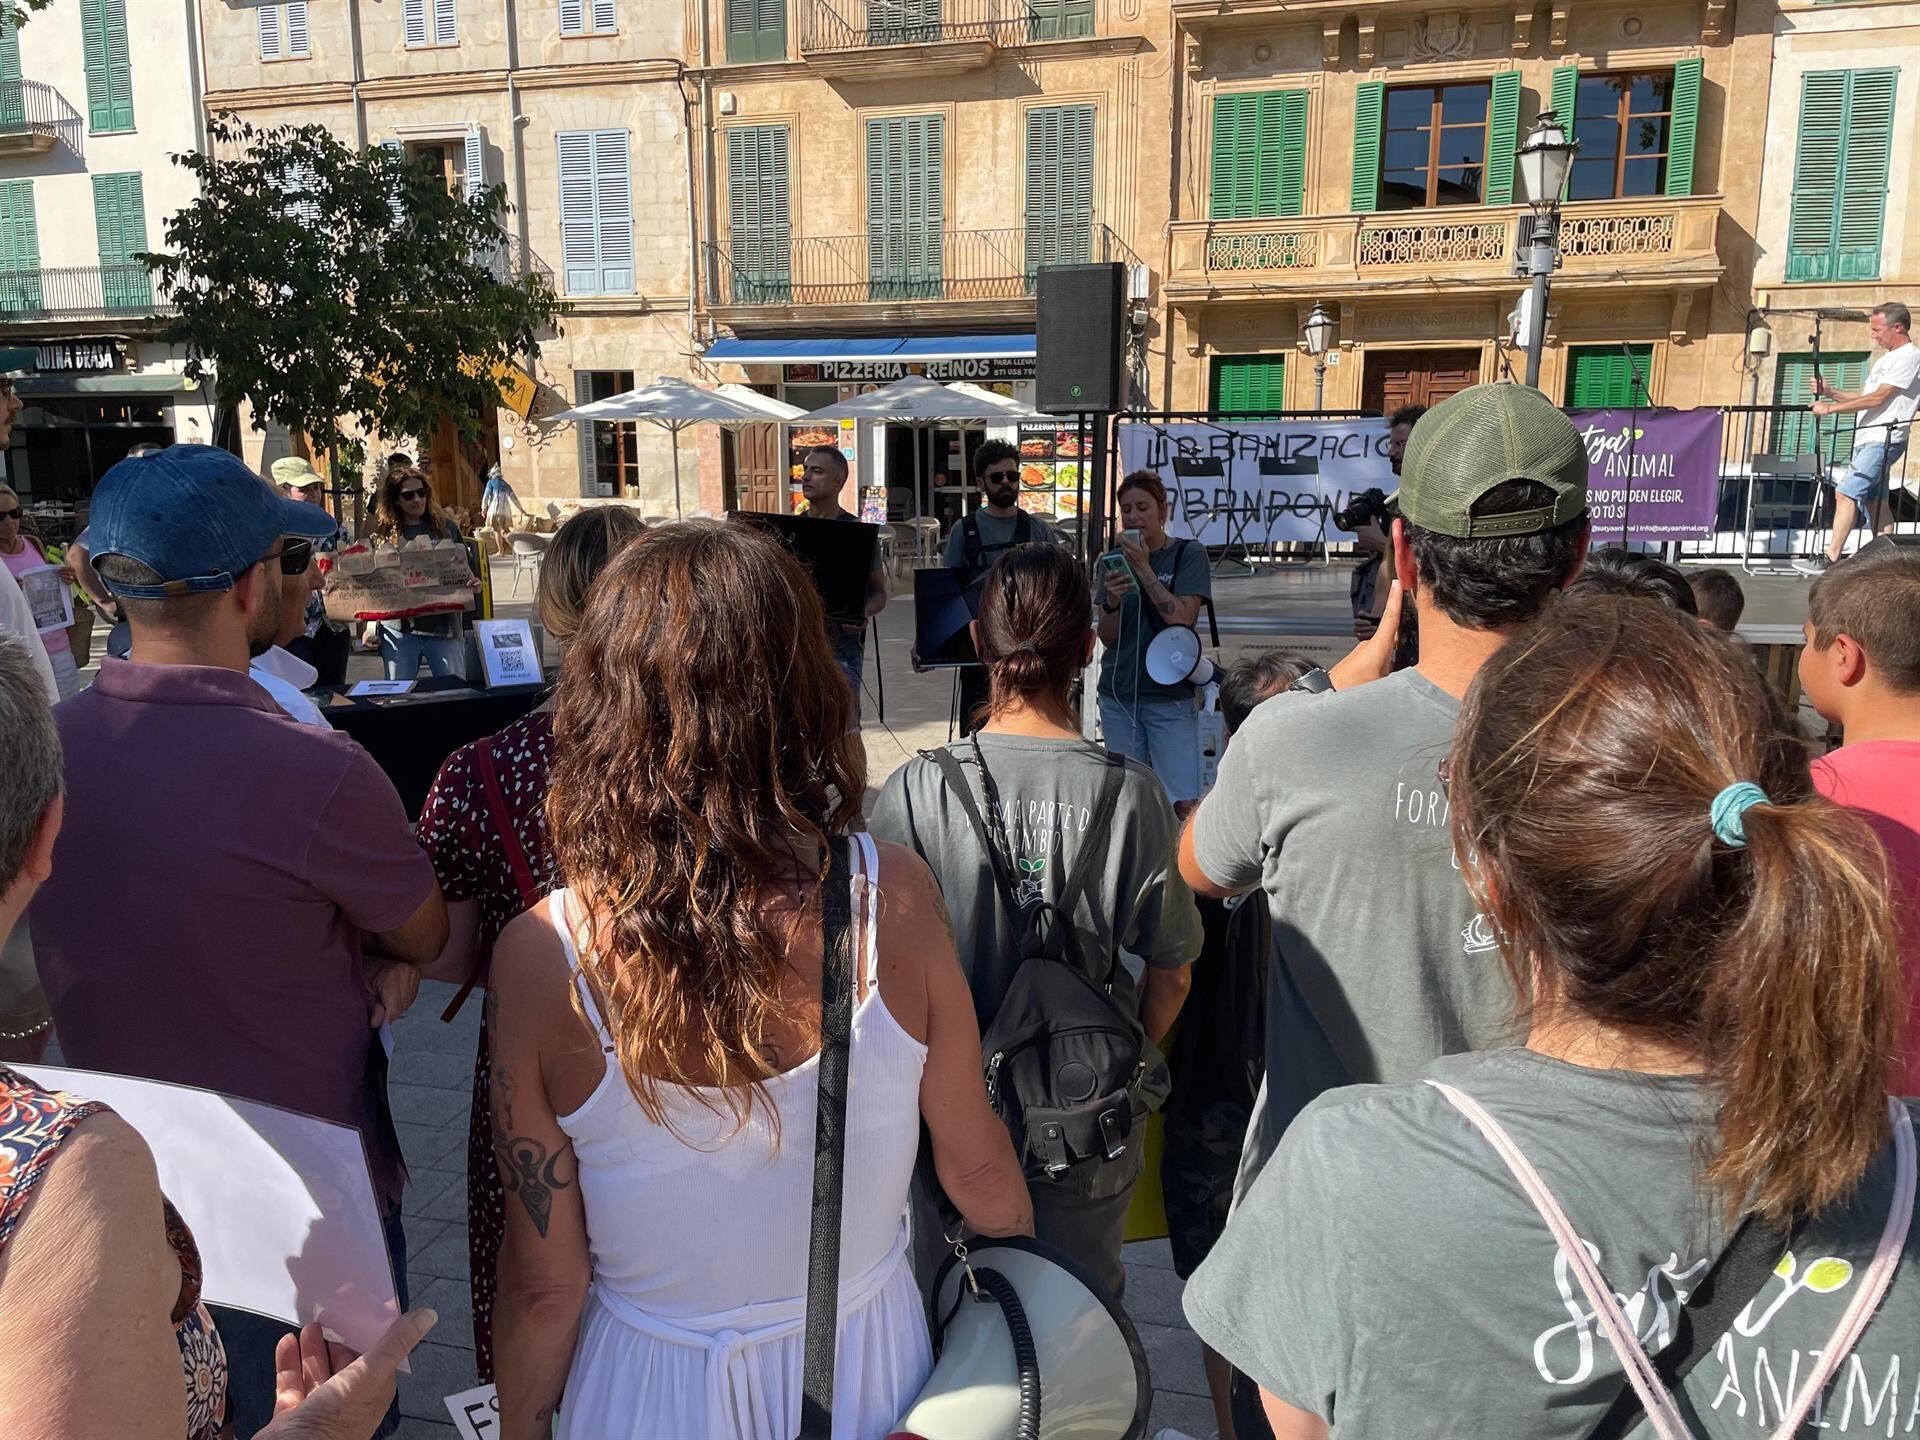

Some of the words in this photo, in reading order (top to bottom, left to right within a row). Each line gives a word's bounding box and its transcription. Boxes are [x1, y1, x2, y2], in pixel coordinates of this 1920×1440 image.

[76, 345, 113, 369] BRASA
[822, 361, 903, 380] PIZZERIA
[926, 359, 990, 379] REINOS
[1021, 422, 1055, 431] PIZZERIA
[1146, 433, 1391, 469] URBANIZACIO
[1580, 424, 1631, 465] tya
[1604, 452, 1675, 478] ANIMAL
[1595, 490, 1610, 503] NO
[1650, 490, 1684, 504] ELEGIR,
[1603, 504, 1615, 519] TÚ
[1029, 800, 1074, 830] PARTE
